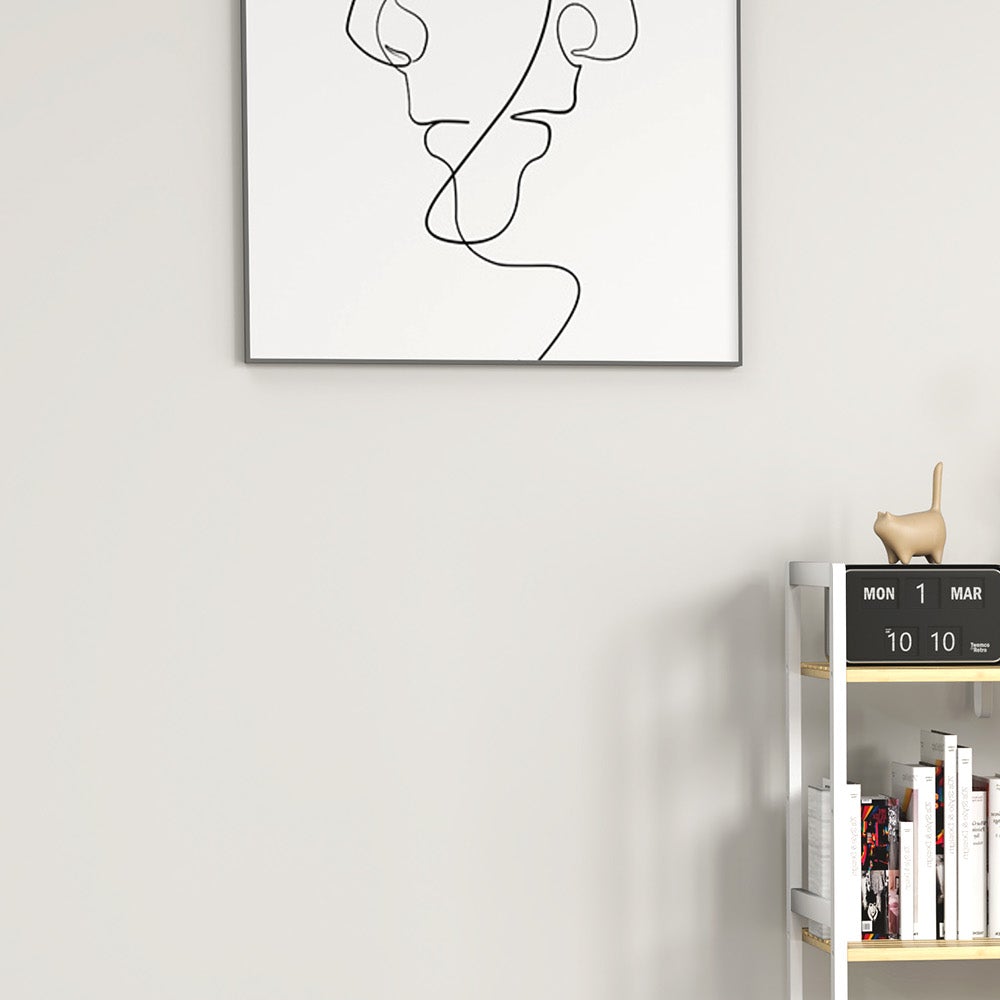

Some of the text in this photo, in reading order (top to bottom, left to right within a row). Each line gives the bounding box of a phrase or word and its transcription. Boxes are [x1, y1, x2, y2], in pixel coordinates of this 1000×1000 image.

[863, 583, 982, 604] MON 1 MAR
[887, 631, 956, 652] 10 10
